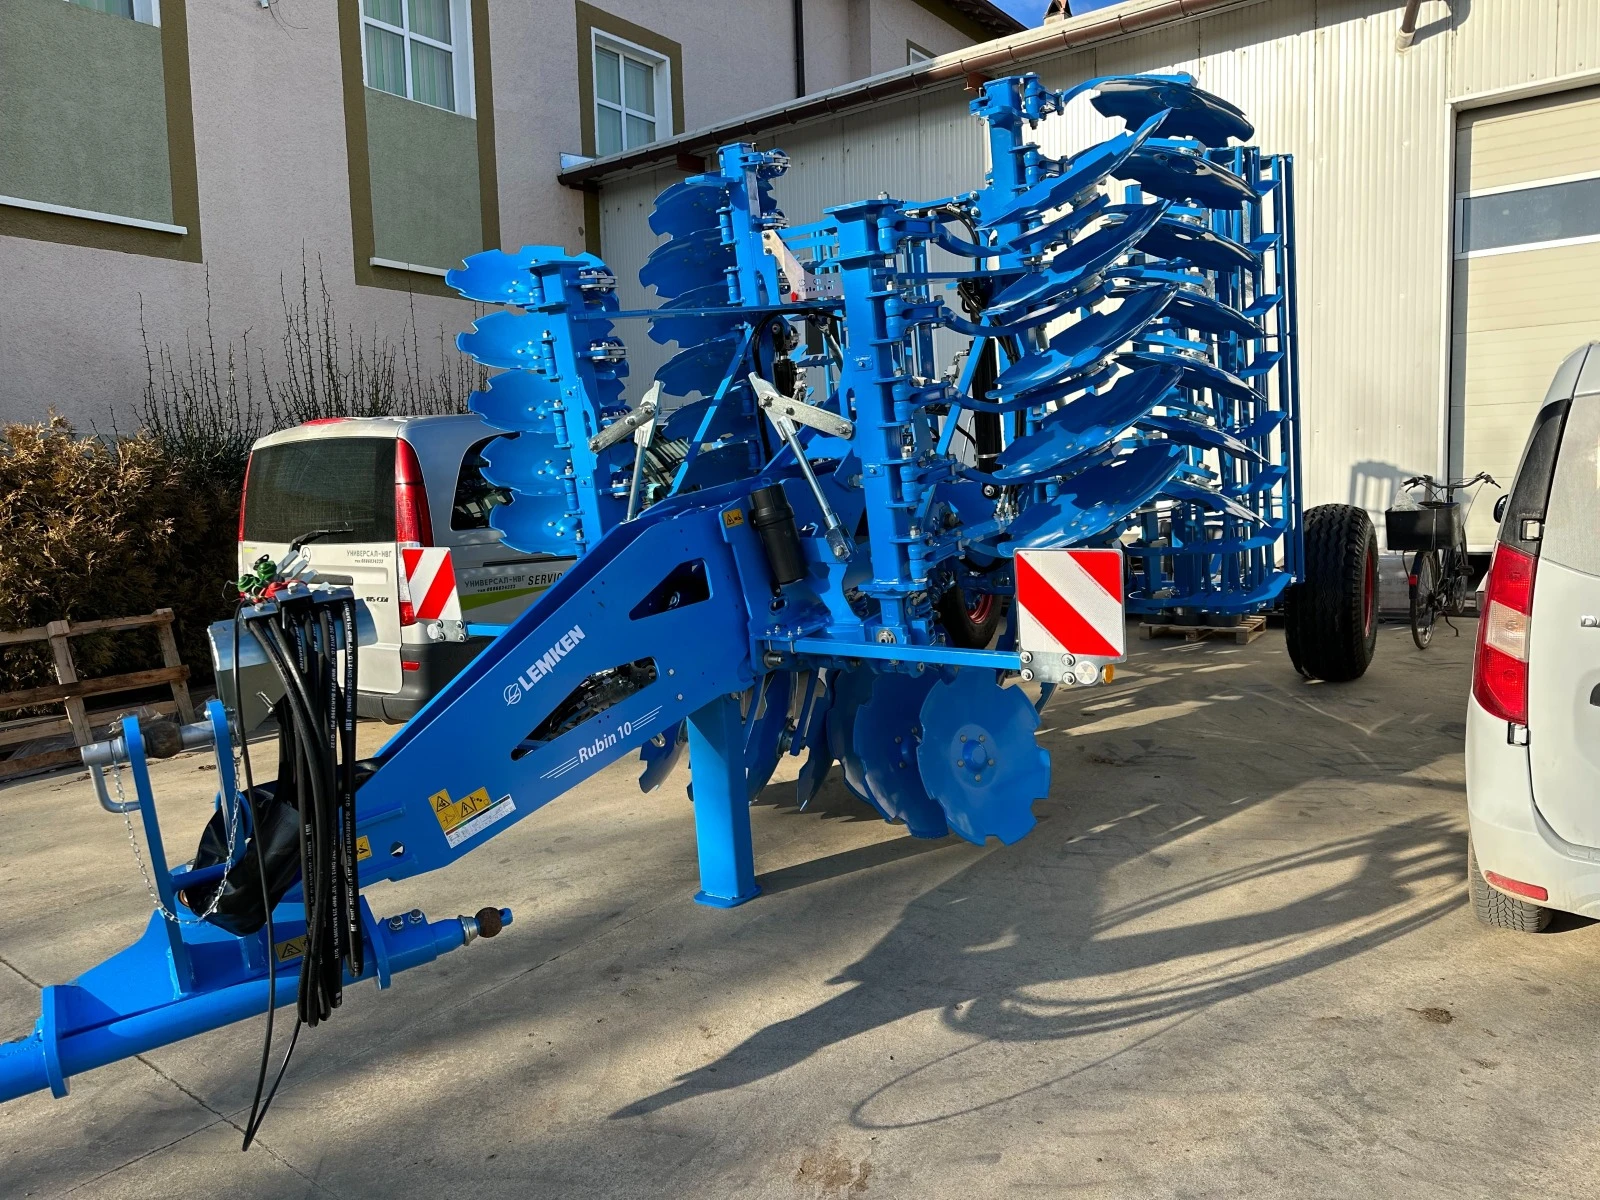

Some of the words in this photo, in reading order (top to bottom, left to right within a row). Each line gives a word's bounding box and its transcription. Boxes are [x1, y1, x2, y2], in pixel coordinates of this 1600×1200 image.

[465, 575, 526, 588] УНИВЕРСАЛ-НВГ
[518, 624, 586, 692] LEMKEN
[578, 733, 617, 764] Rubin
[617, 721, 632, 740] 10
